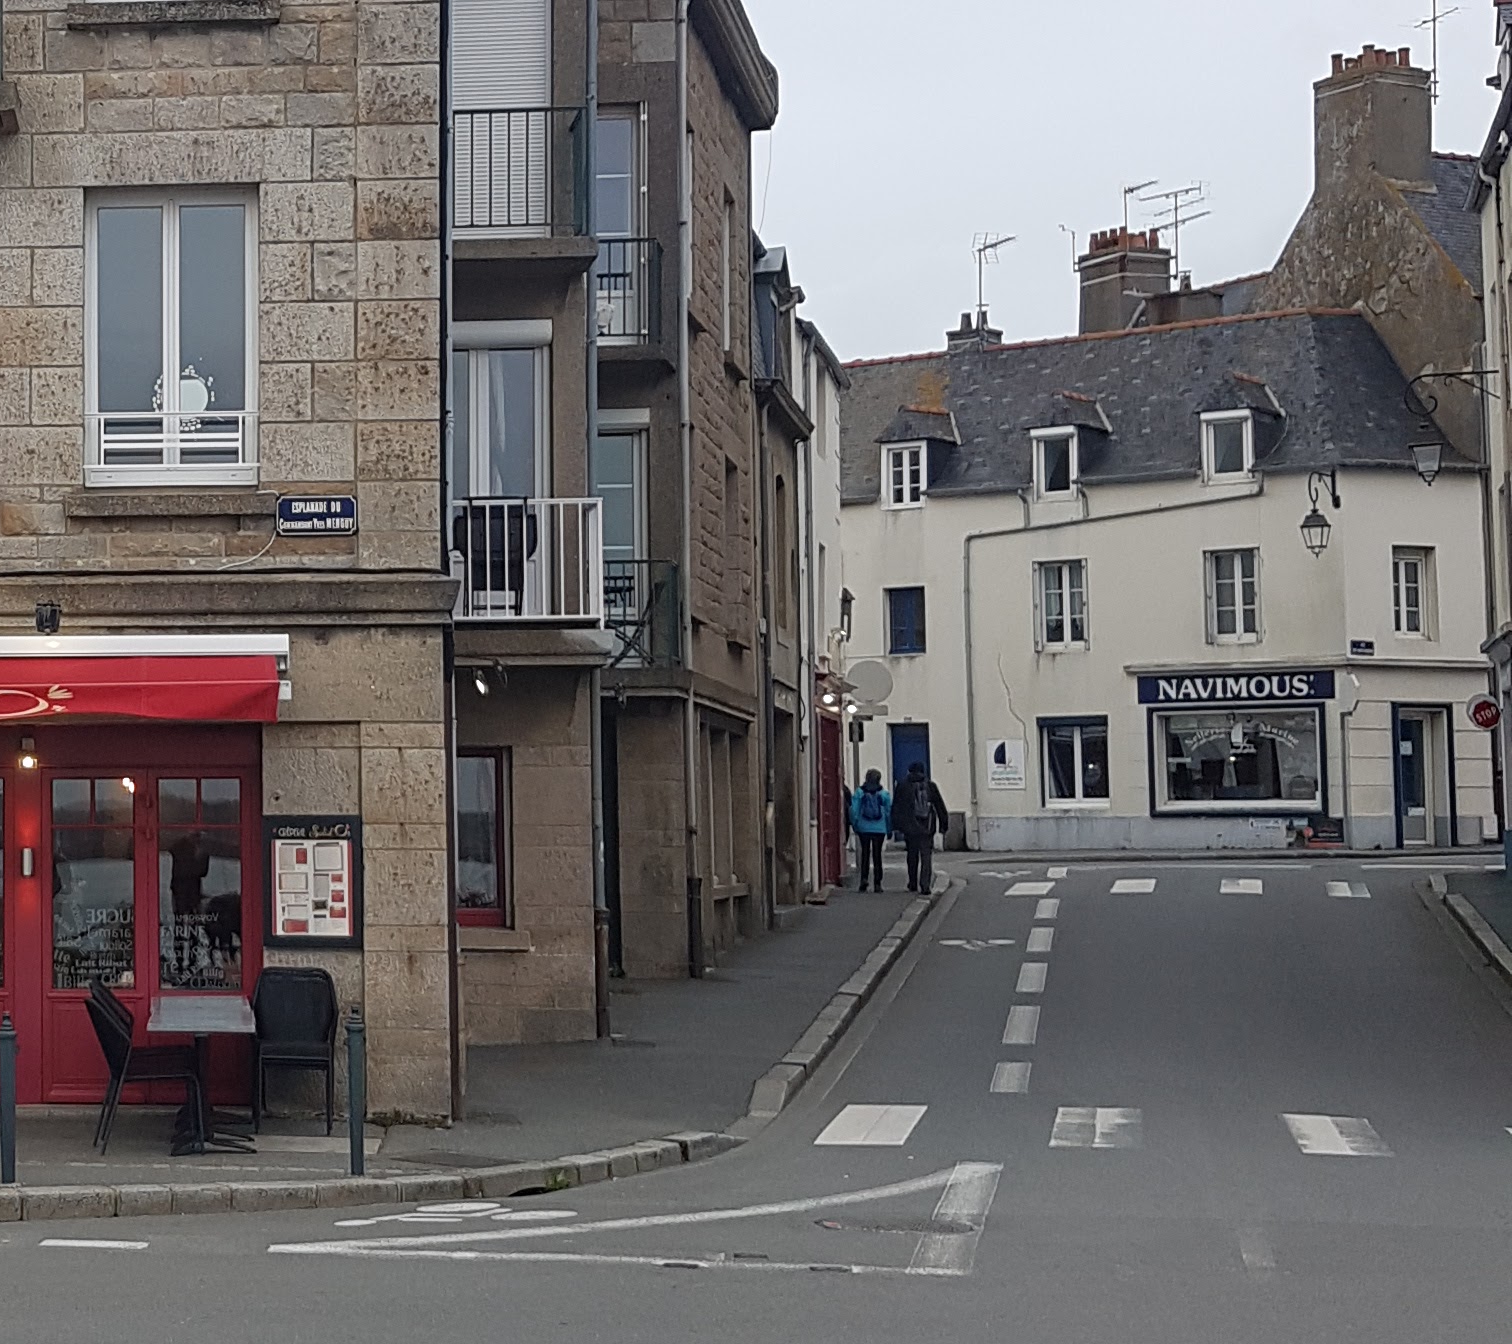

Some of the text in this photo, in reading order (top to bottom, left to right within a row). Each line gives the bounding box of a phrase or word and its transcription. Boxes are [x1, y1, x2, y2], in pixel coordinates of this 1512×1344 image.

[291, 501, 341, 514] ESPLANADE DU
[1475, 706, 1497, 723] STOP
